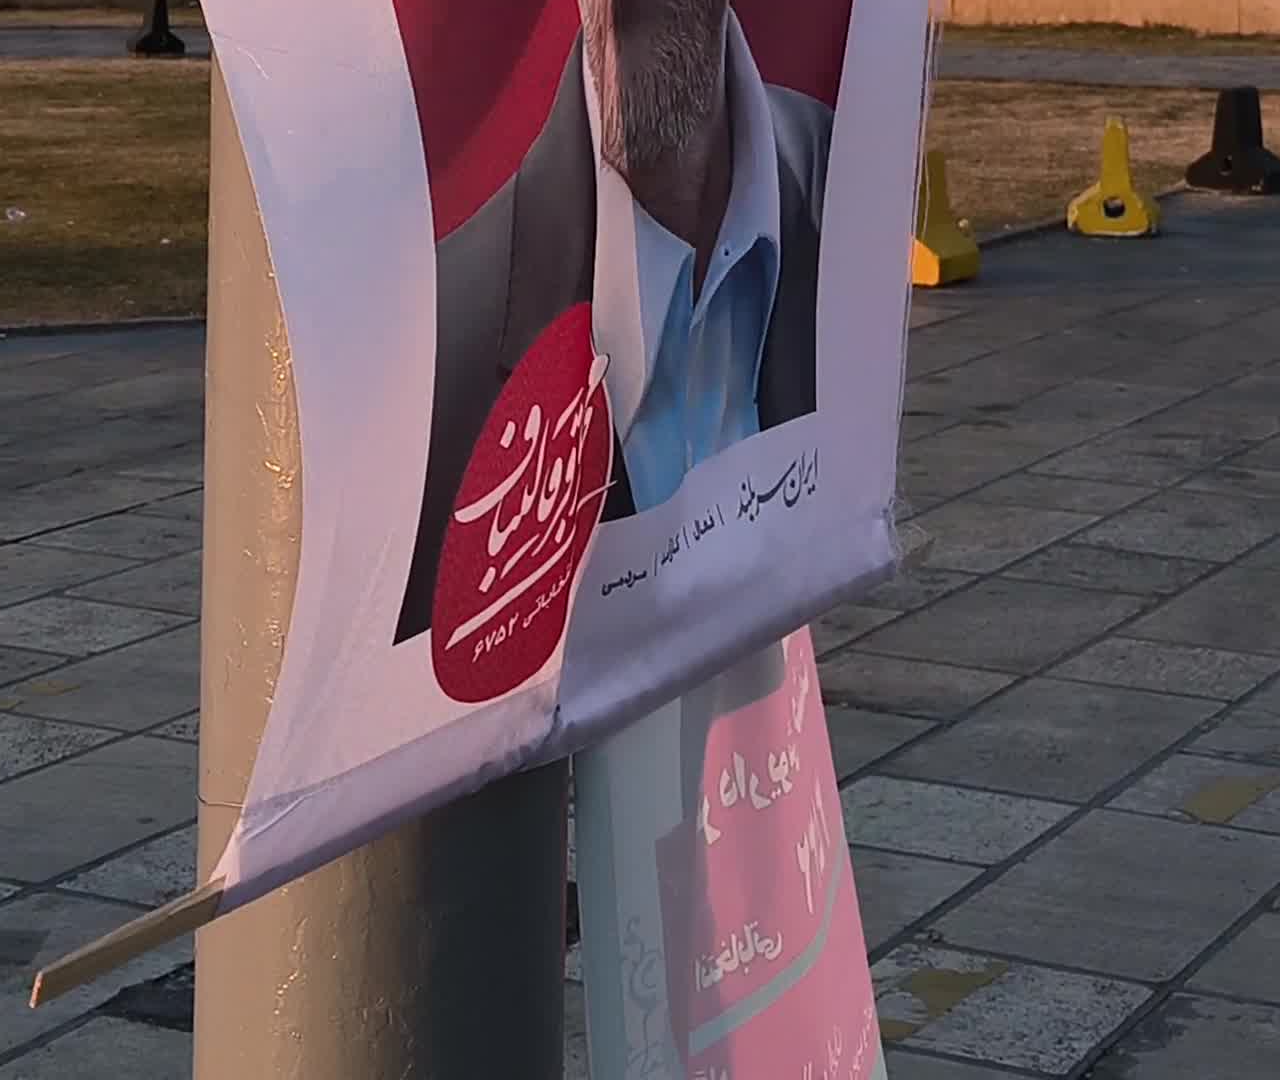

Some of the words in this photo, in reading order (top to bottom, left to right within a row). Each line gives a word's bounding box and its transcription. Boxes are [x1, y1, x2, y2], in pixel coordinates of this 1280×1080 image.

[736, 460, 798, 522] سربلند
[782, 447, 819, 508] ایران
[472, 612, 520, 664] ۶۷۵۲
